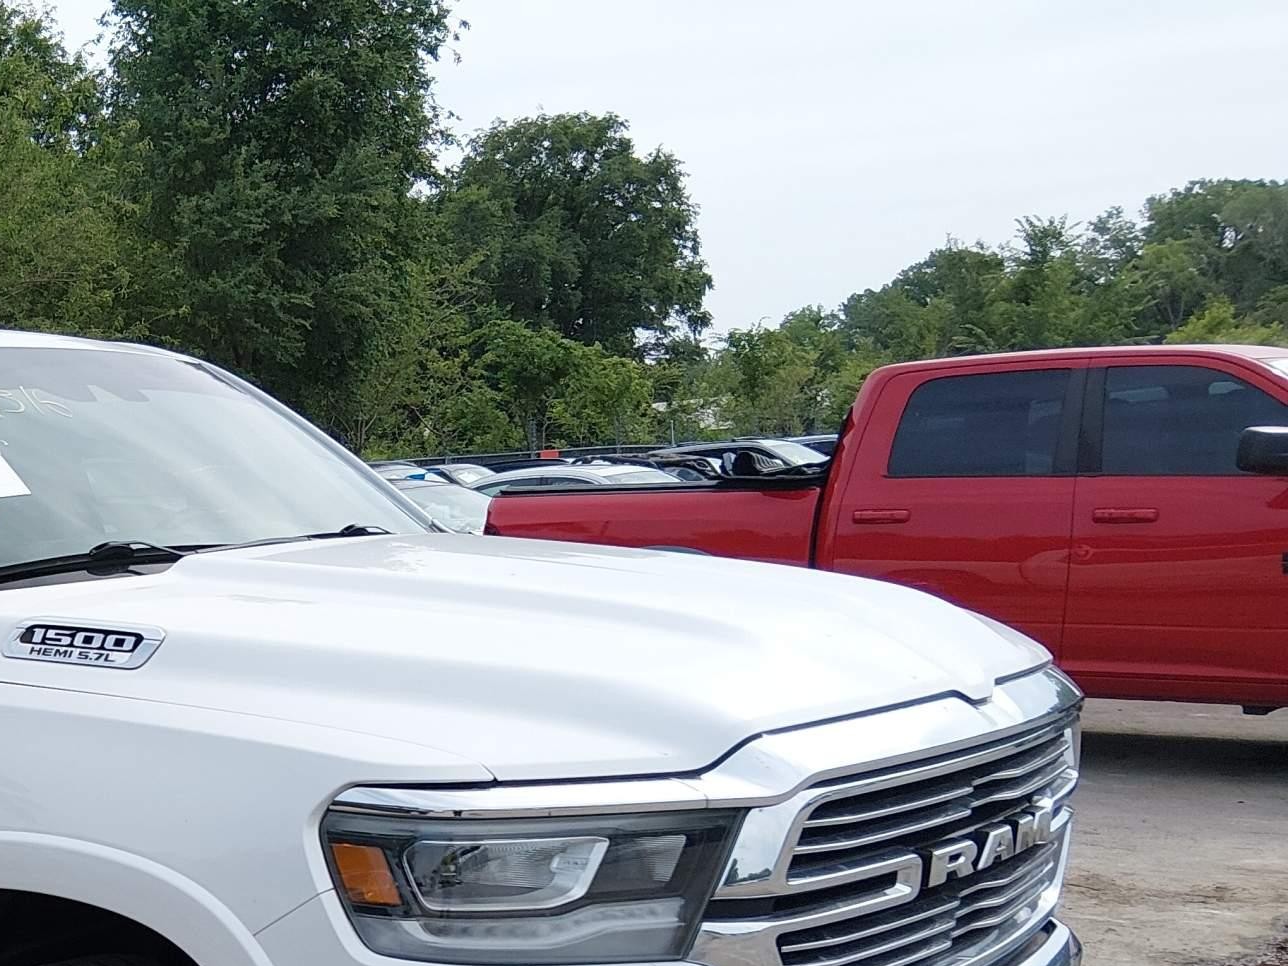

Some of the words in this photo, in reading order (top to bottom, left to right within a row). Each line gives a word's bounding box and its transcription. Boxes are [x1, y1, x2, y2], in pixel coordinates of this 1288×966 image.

[30, 627, 137, 652] 1500
[28, 646, 74, 659] HEMI
[76, 651, 116, 662] 5.7L
[926, 804, 1053, 889] RAM
